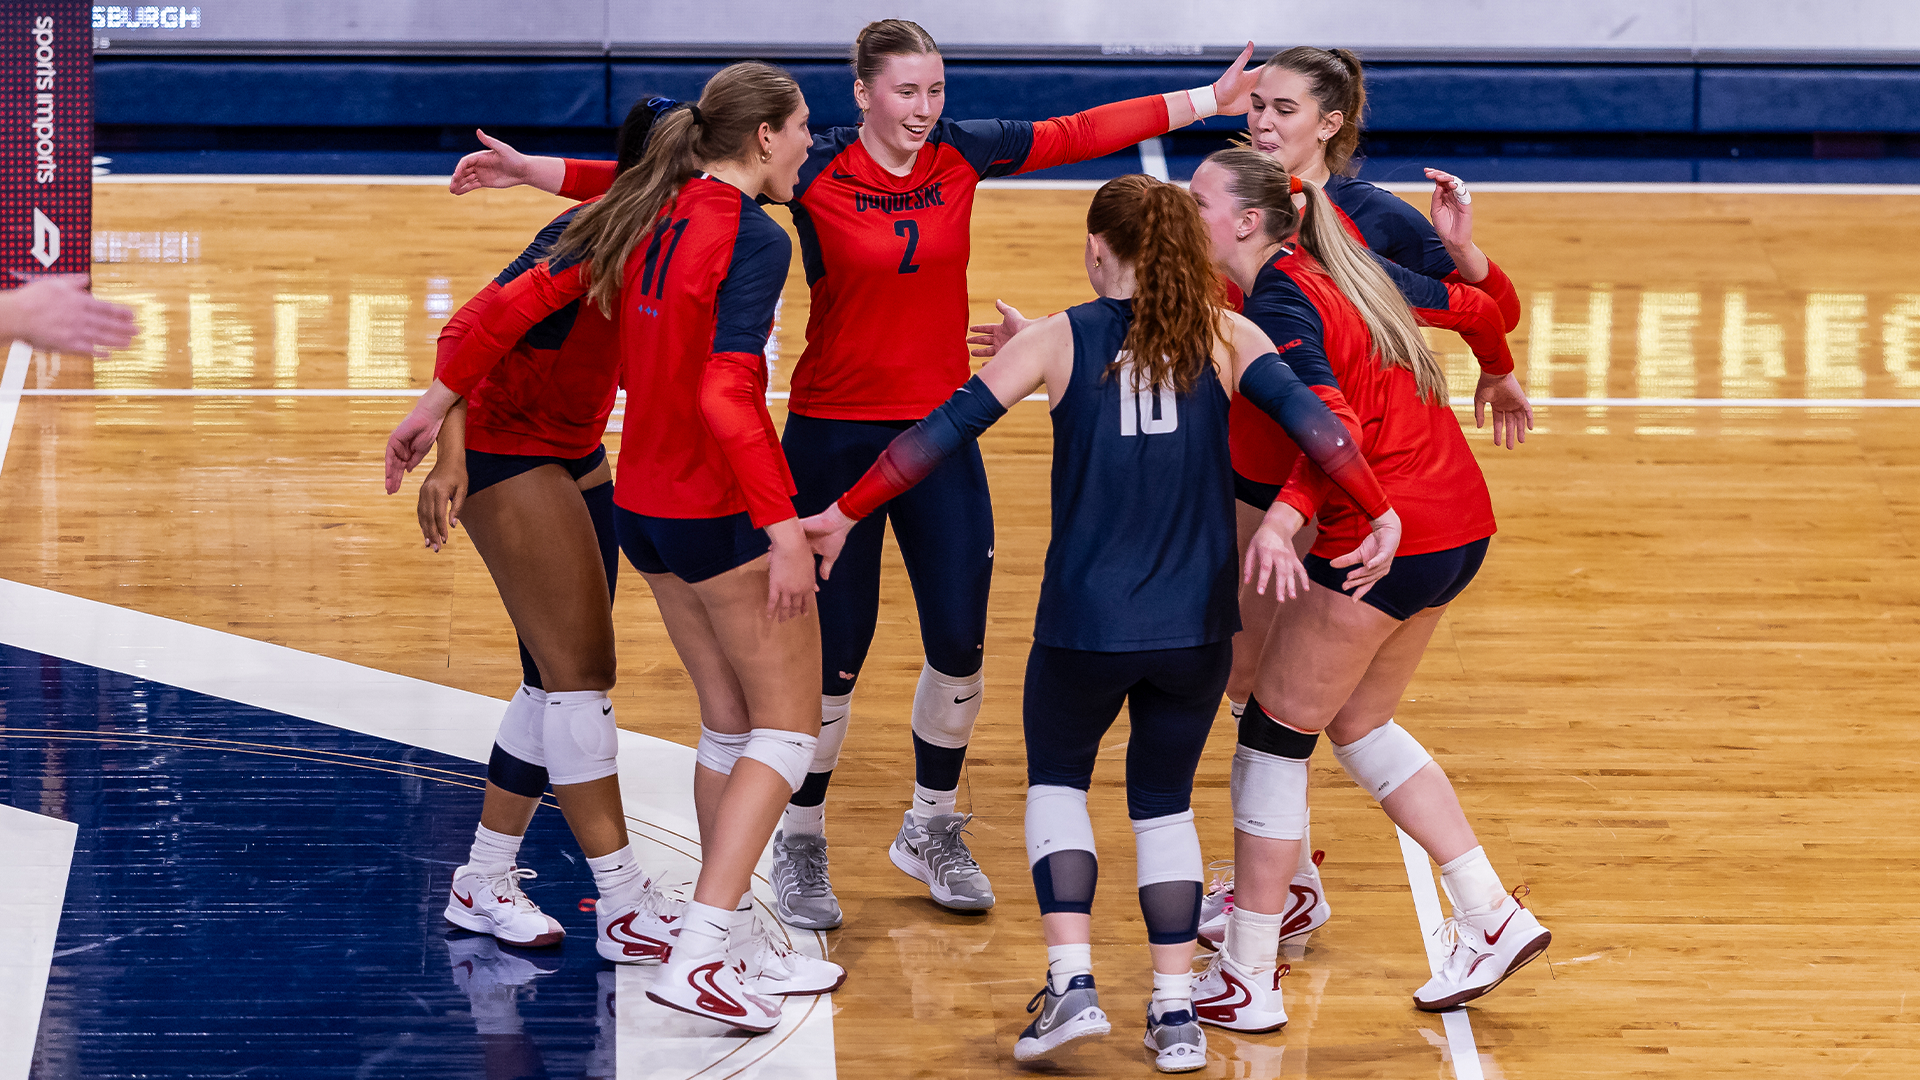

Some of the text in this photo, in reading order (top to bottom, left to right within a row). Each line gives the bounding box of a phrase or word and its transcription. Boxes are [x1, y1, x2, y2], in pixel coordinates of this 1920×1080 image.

[31, 16, 57, 183] sports imports
[855, 182, 945, 214] DUQUESNE
[641, 217, 690, 300] 11
[893, 219, 920, 274] 2
[1114, 349, 1178, 436] 10
